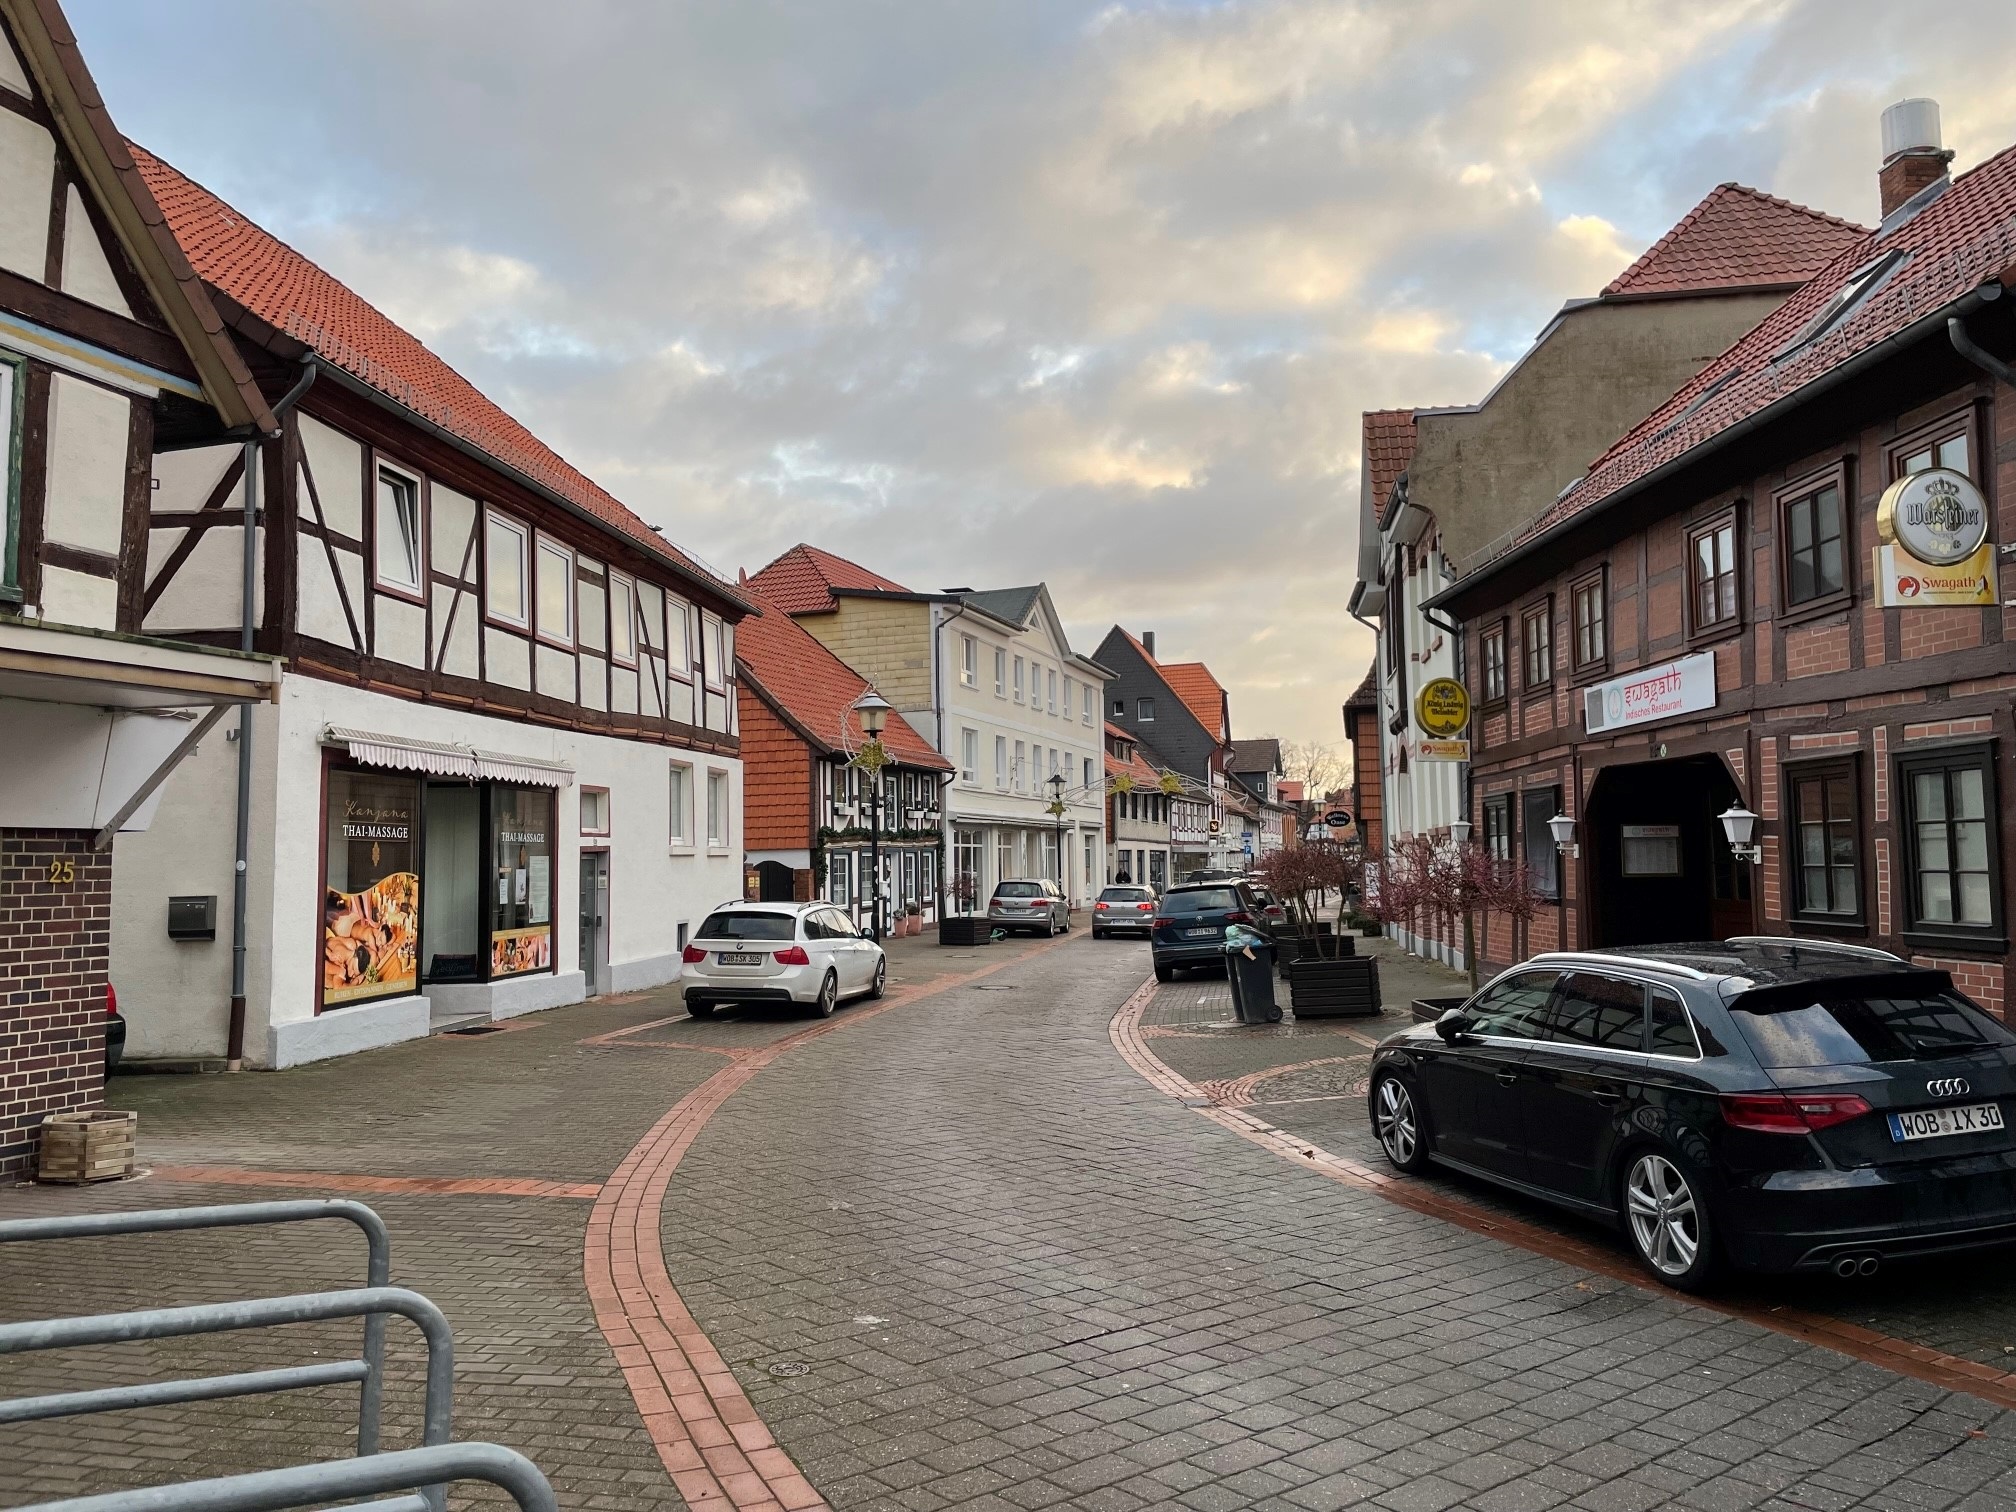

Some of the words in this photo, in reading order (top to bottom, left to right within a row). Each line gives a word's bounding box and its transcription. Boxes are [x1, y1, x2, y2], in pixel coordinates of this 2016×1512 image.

[1907, 502, 1980, 530] Warsteiner
[1922, 576, 1976, 591] Swagath
[1625, 707, 1651, 720] Indisches
[1651, 699, 1682, 715] Restaurant
[343, 799, 409, 823] Kanjana
[342, 825, 409, 839] THAI-MASSAGE
[501, 832, 545, 843] THAI-MASSAGE
[50, 861, 75, 883] 25
[1900, 1113, 1940, 1137] WOB
[1951, 1109, 1977, 1131] IX
[1976, 1106, 2001, 1127] 30
